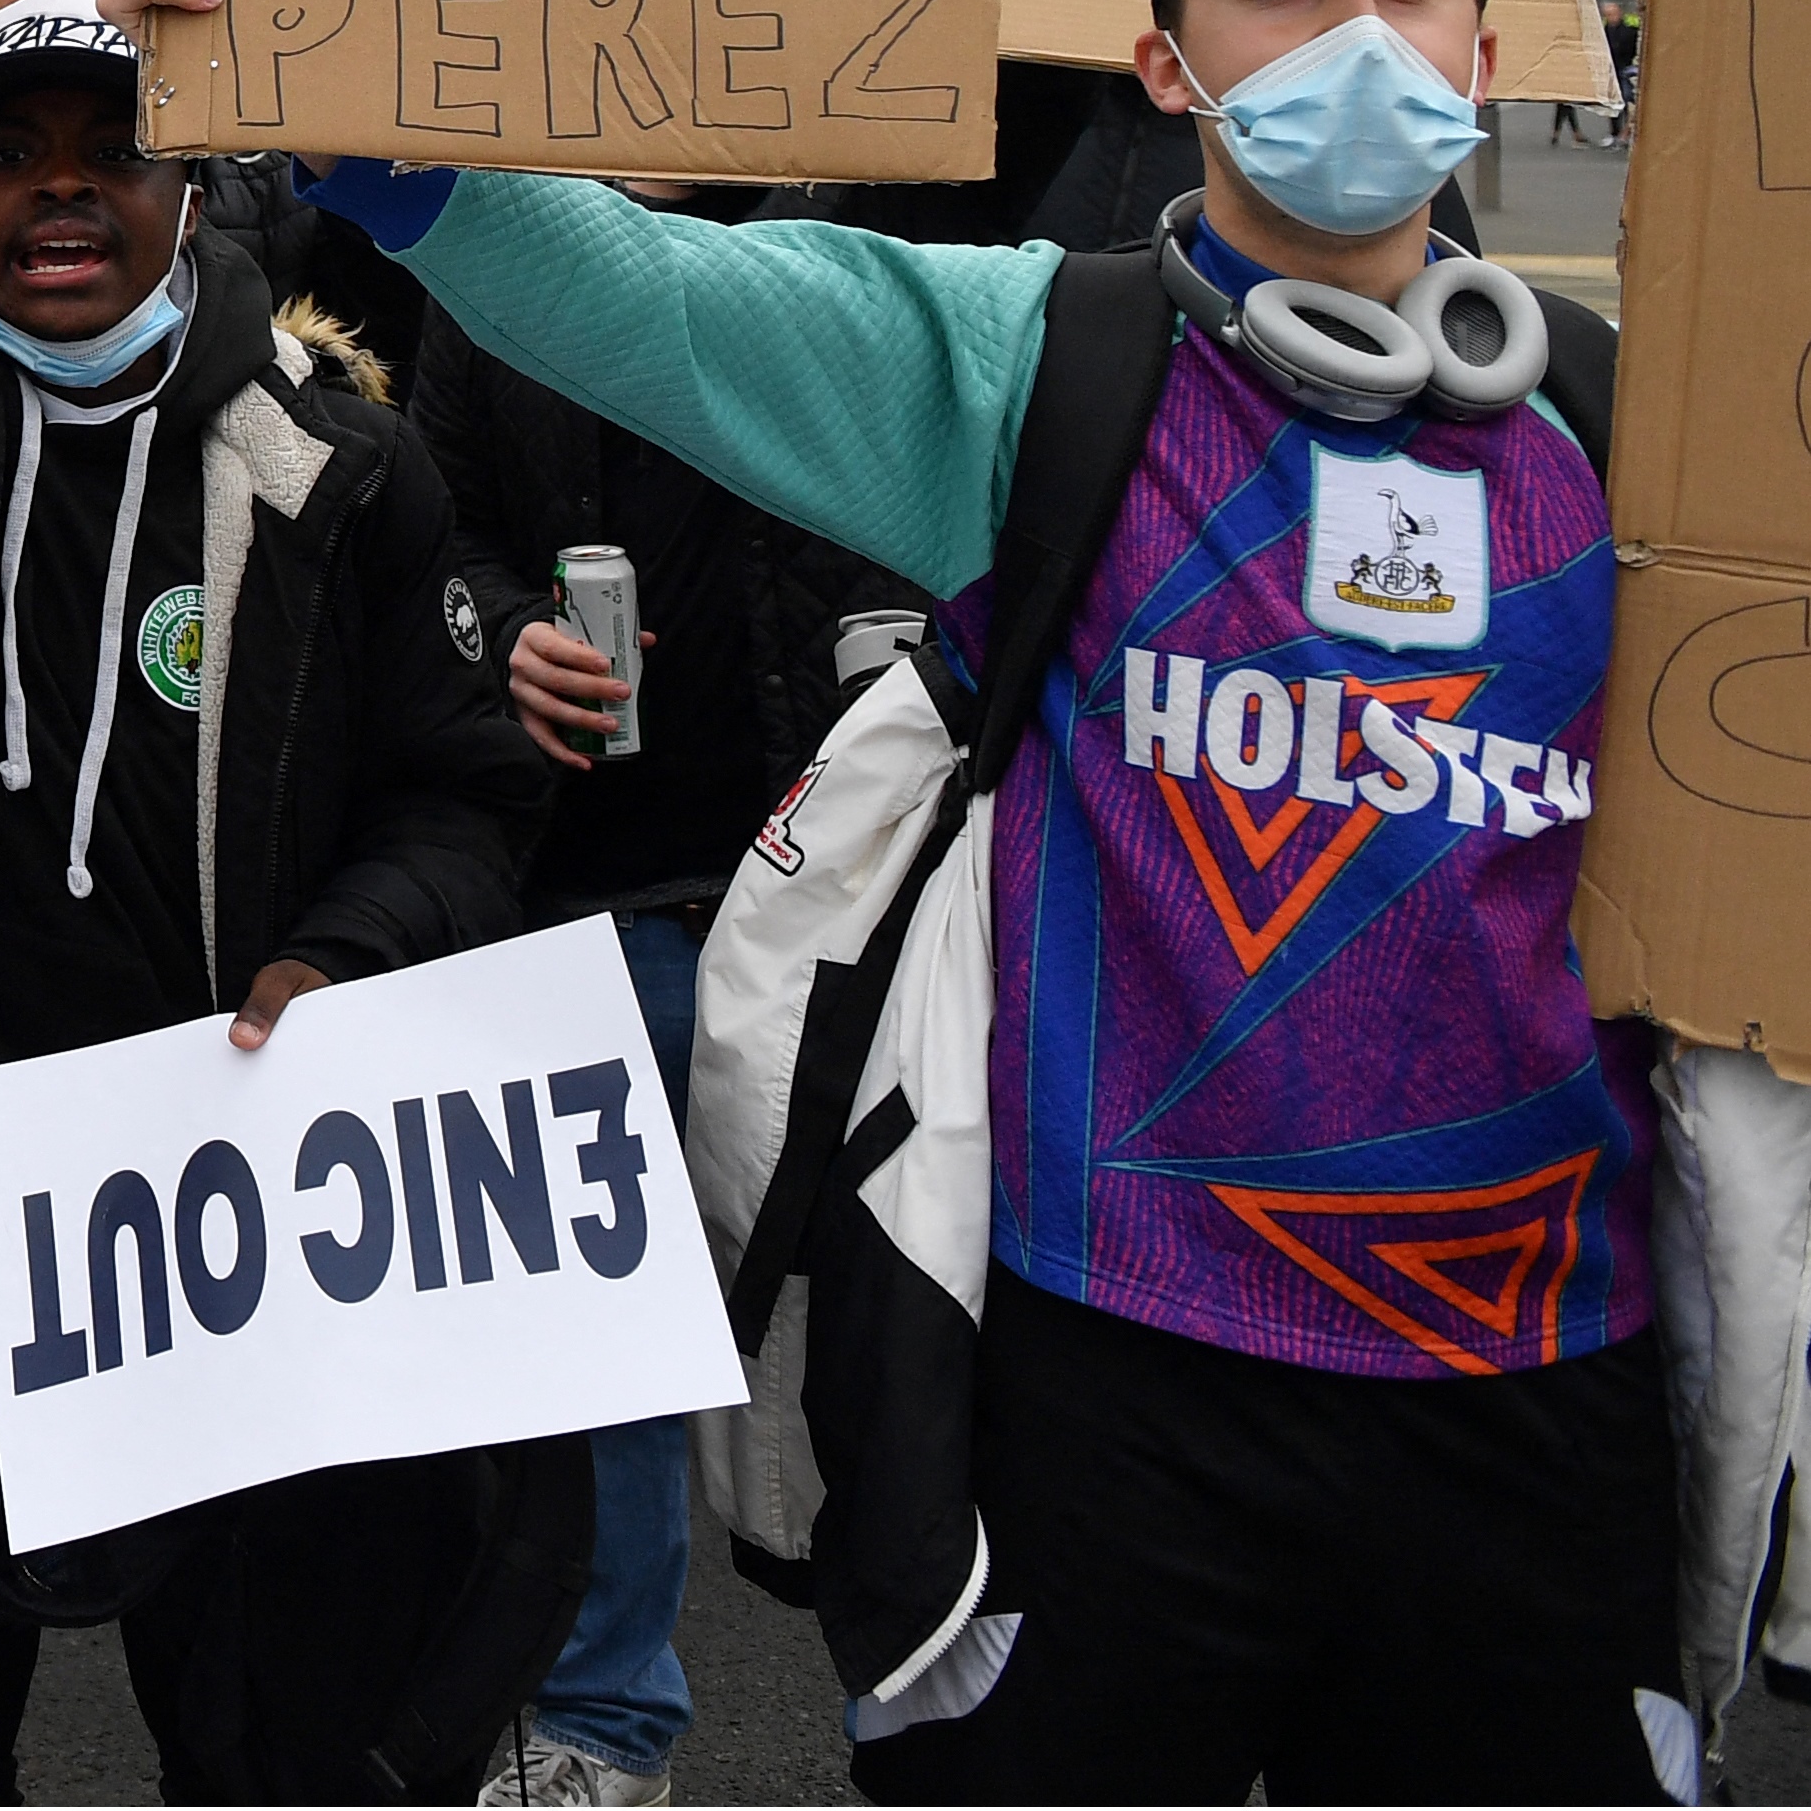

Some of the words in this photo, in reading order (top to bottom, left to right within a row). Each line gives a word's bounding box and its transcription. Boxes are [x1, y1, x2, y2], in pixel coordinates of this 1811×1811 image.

[181, 691, 200, 705] FC
[1123, 646, 1593, 839] HOLSTEN
[11, 1139, 267, 1396] OUT
[294, 1057, 649, 1304] £NIC
